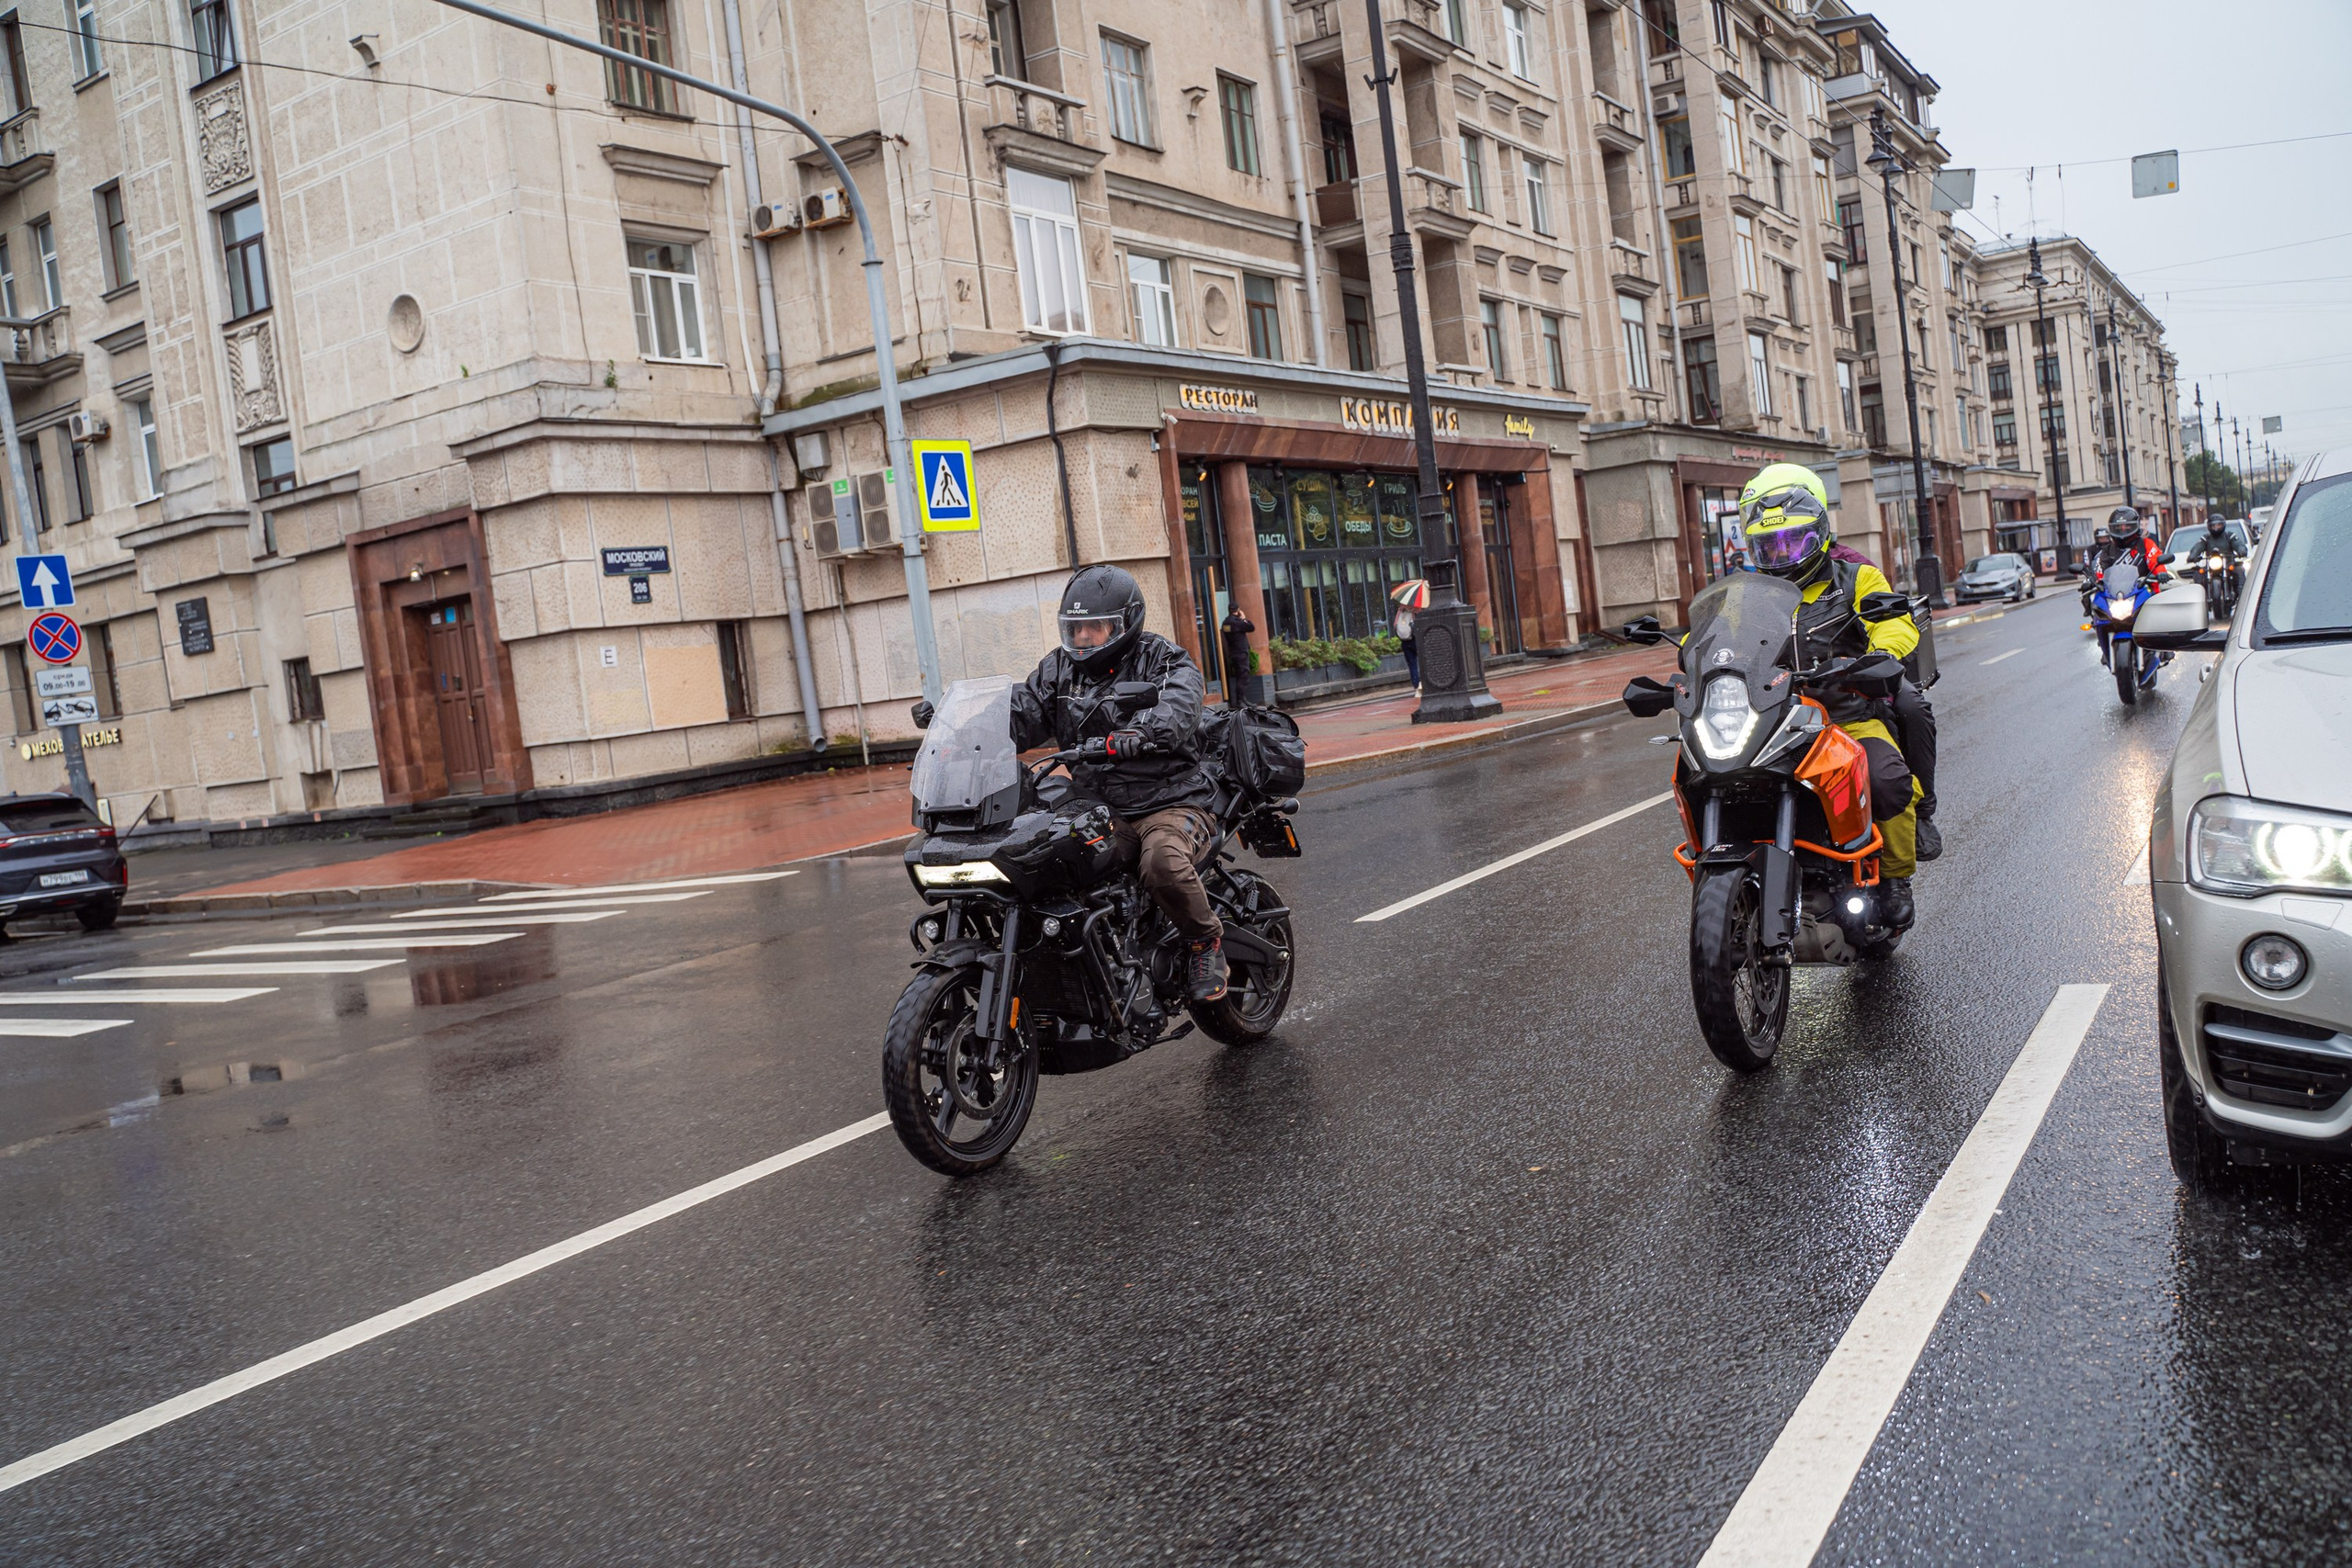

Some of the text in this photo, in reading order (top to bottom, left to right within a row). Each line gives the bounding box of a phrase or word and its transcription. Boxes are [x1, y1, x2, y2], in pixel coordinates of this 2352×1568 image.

[1182, 385, 1258, 412] РЕСТОРАН
[1341, 397, 1460, 436] КОМПИЯ
[1505, 413, 1535, 440] family
[1295, 479, 1322, 491] СУШИ
[1384, 482, 1408, 494] ГРИЛЬ
[1345, 520, 1373, 534] ОБЕДЫ
[1762, 516, 1784, 527] SHOEI
[1259, 533, 1287, 547] ПАСТА
[606, 548, 666, 565] МОСКОВСКИЙ
[633, 582, 649, 593] 206
[81, 728, 119, 749] АТЕЛЬЕ
